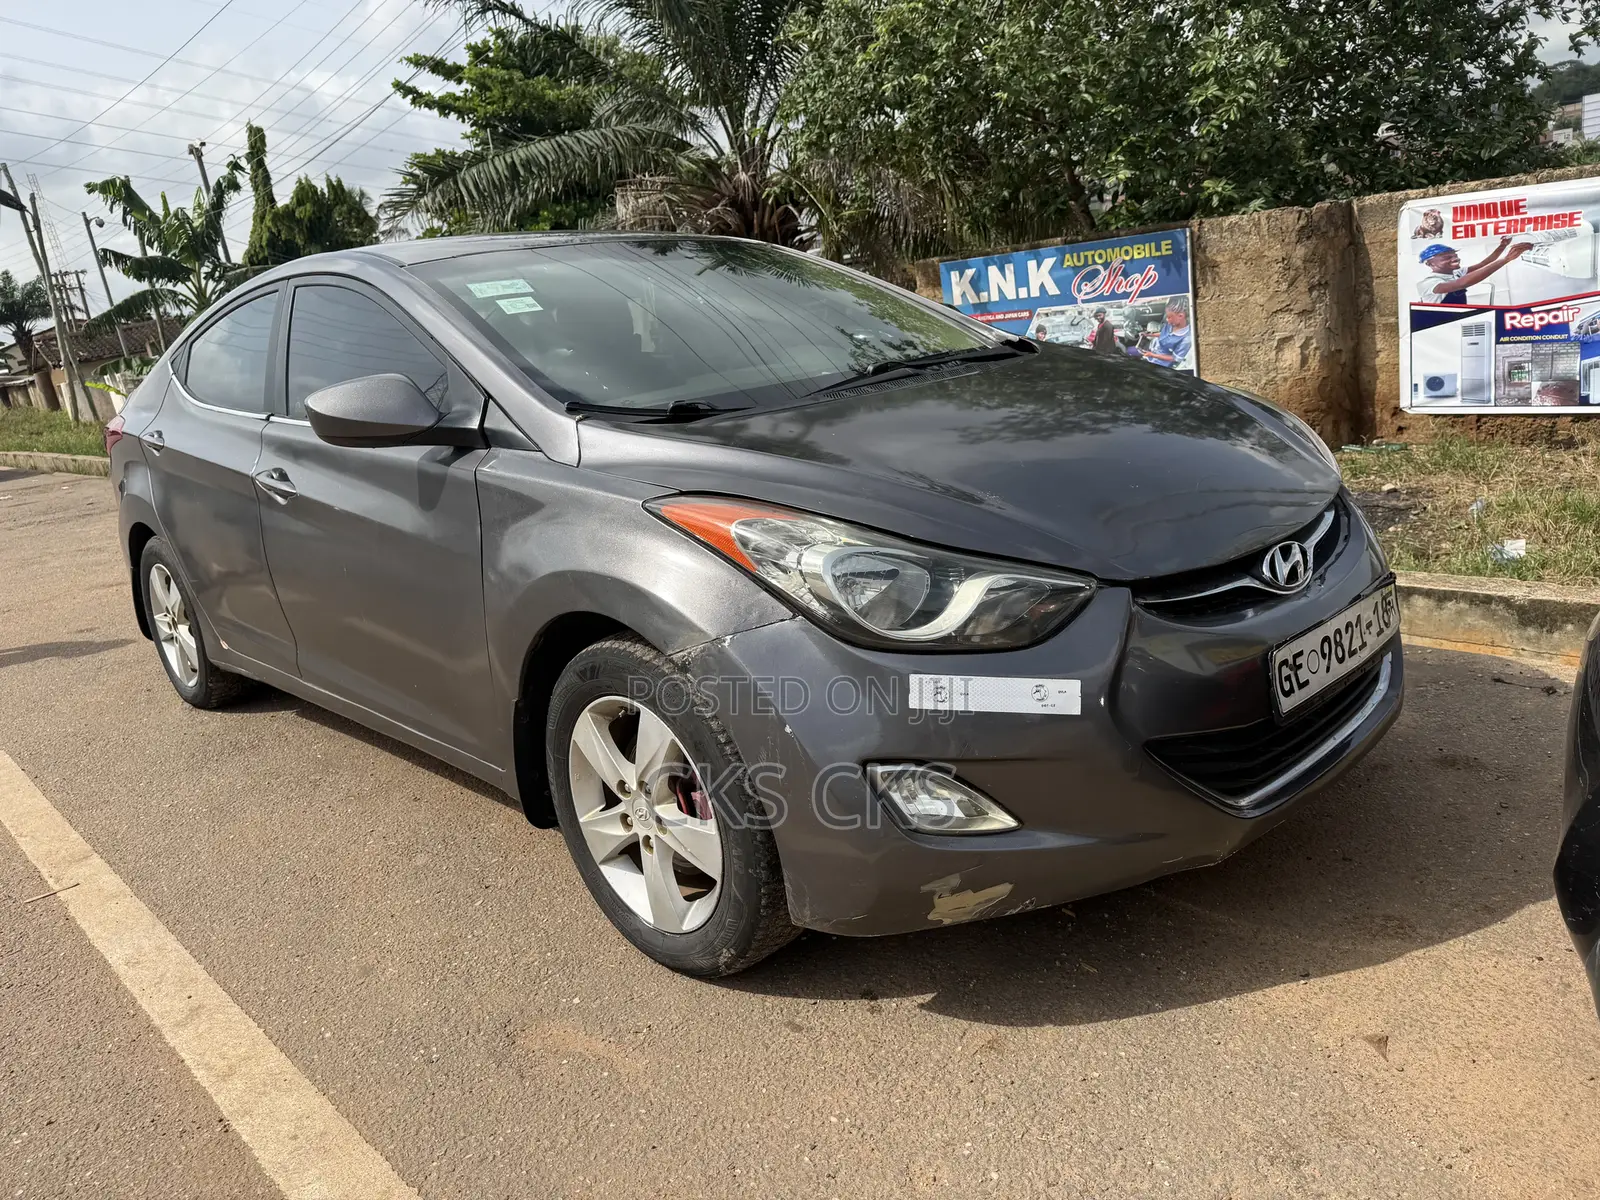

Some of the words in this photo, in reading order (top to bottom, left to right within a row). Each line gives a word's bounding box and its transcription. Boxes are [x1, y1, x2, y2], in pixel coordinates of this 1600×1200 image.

[1452, 198, 1527, 223] UNIQUE
[1452, 211, 1583, 240] ENTERPRISE
[1062, 240, 1173, 268] AUTOMOBILE
[950, 257, 1061, 306] K.N.K
[1071, 257, 1159, 305] Shop
[1504, 305, 1581, 331] Repair
[1277, 650, 1309, 698] GE
